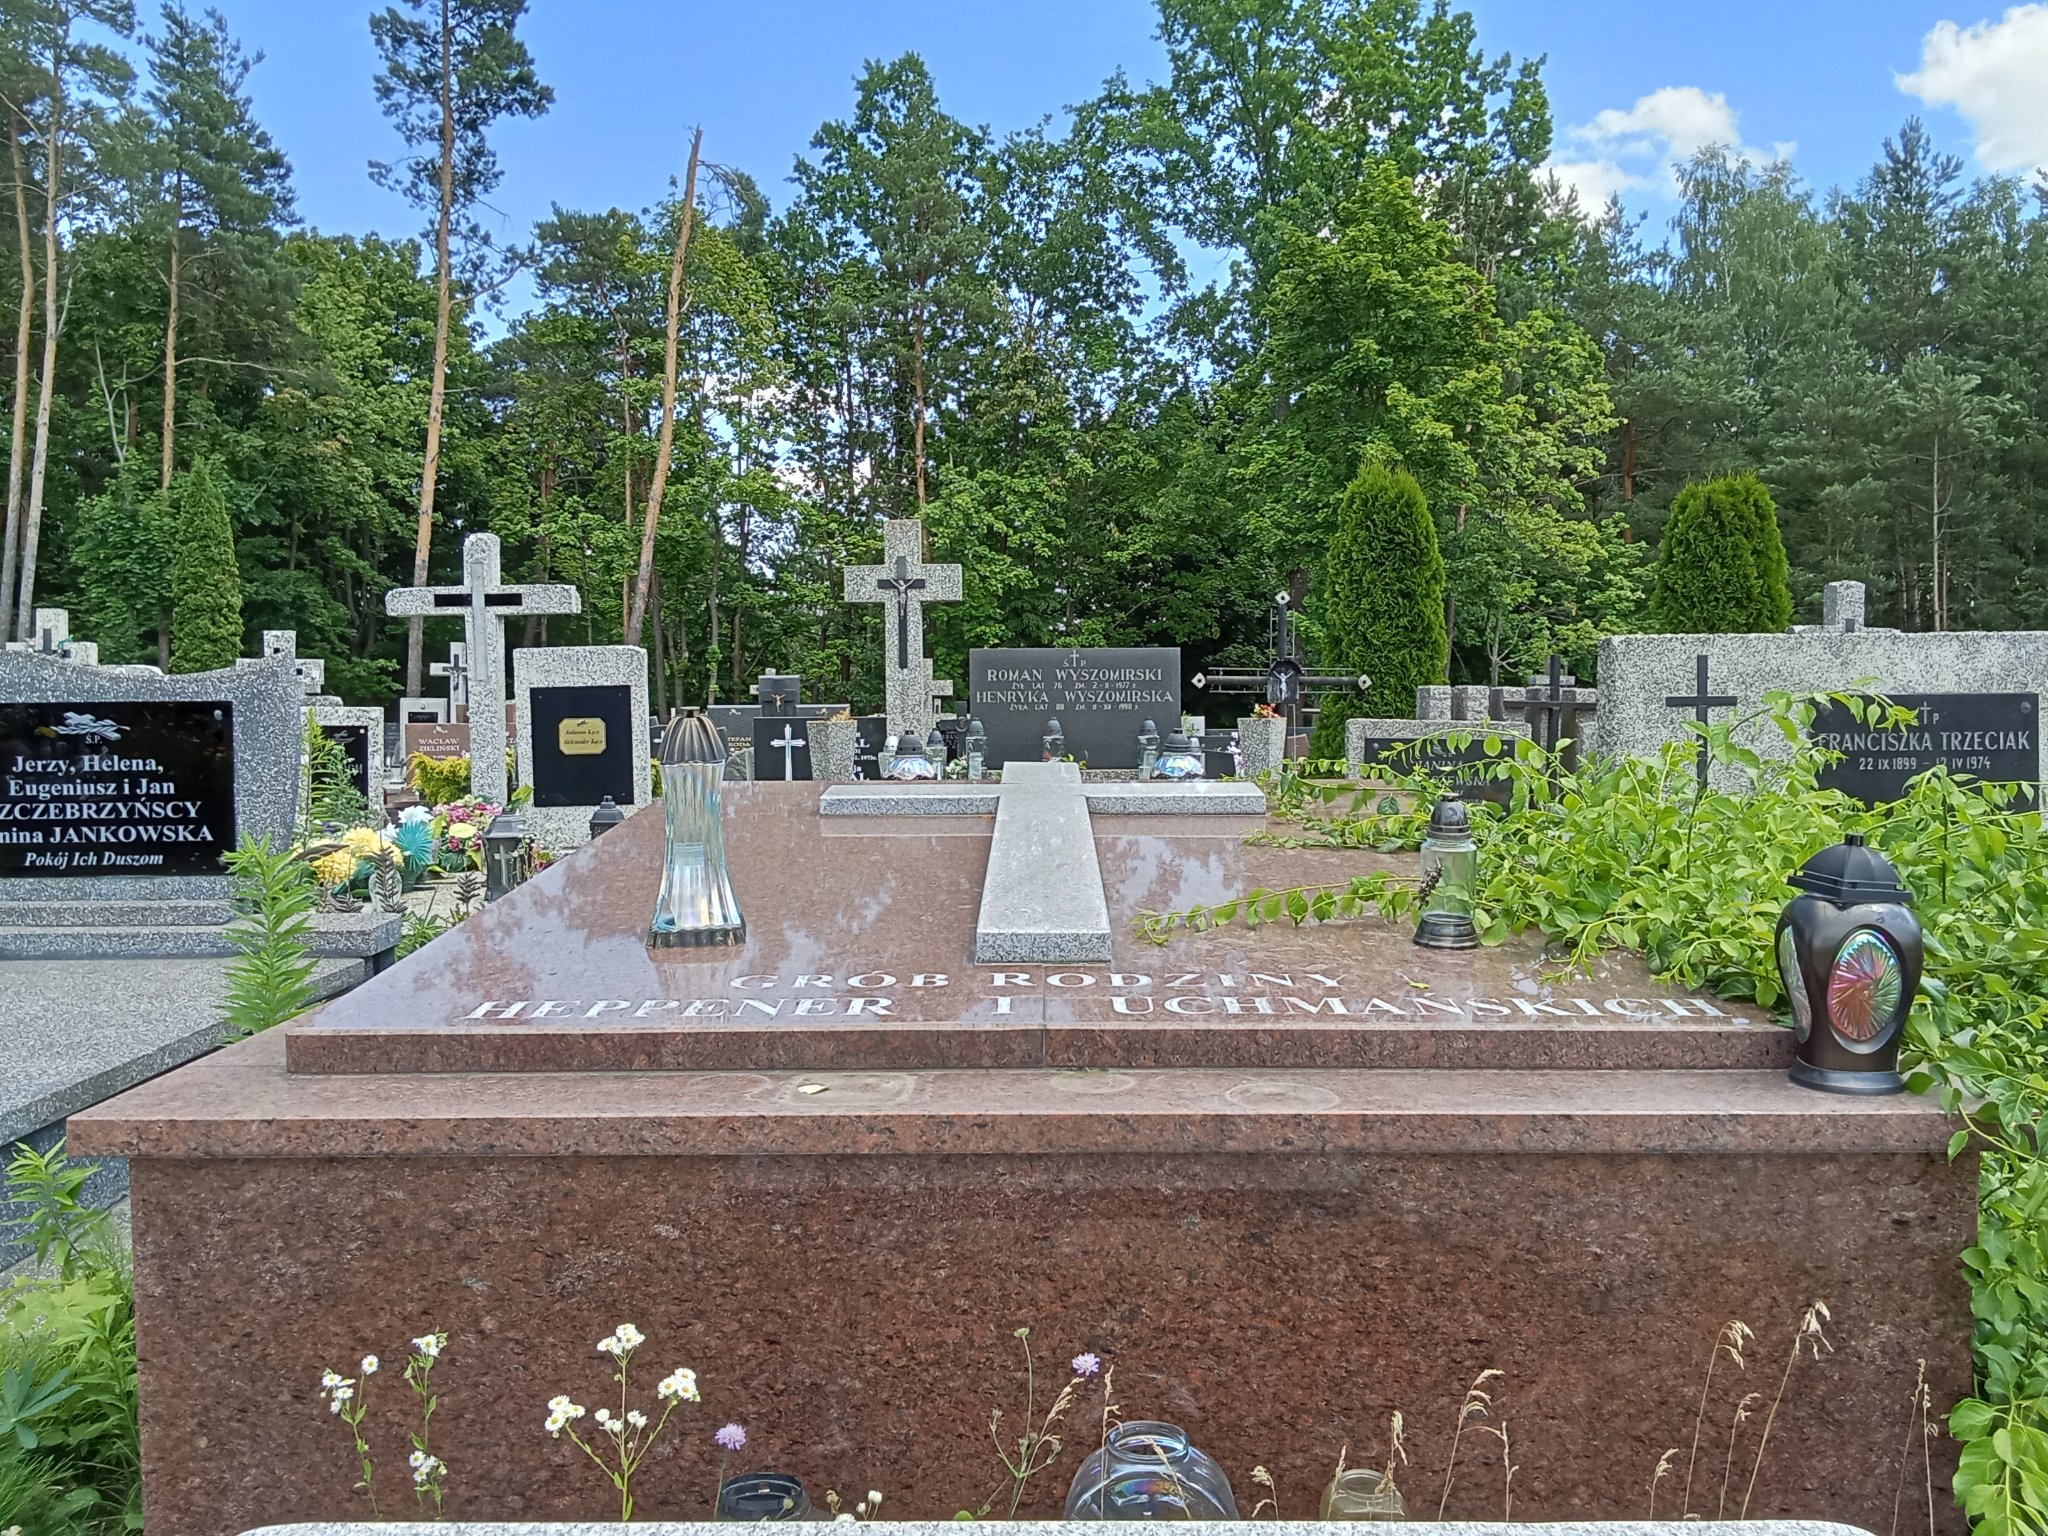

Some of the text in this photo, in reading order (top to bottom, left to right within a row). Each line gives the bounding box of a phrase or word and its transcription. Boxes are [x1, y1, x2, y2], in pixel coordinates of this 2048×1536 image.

[987, 668, 1162, 682] ROMAN WYSZOMIRSKI
[1032, 682, 1045, 690] LAT
[976, 690, 1174, 703] HENRYKA WYSZOMIRSKA
[1035, 703, 1048, 711] LAT
[1818, 731, 2031, 751] FRANCISZKA TRZECIAK
[12, 754, 164, 776] Jerzy, Helena,
[1859, 757, 1874, 771] 22
[1893, 756, 1917, 770] 1899
[1952, 756, 1963, 769] IV
[1967, 756, 1992, 770] 1974
[8, 777, 175, 800] Eugeniusz i Jan
[0, 797, 202, 820] ZCZEBRZYŃSCY
[0, 824, 214, 844] nina JANKOWSKA
[24, 851, 164, 870] Pokój Ich Duszom
[730, 970, 1349, 990] GRÓB RODZINY
[459, 993, 1734, 1020] HEPPENER I UCHMAŃSKICH
